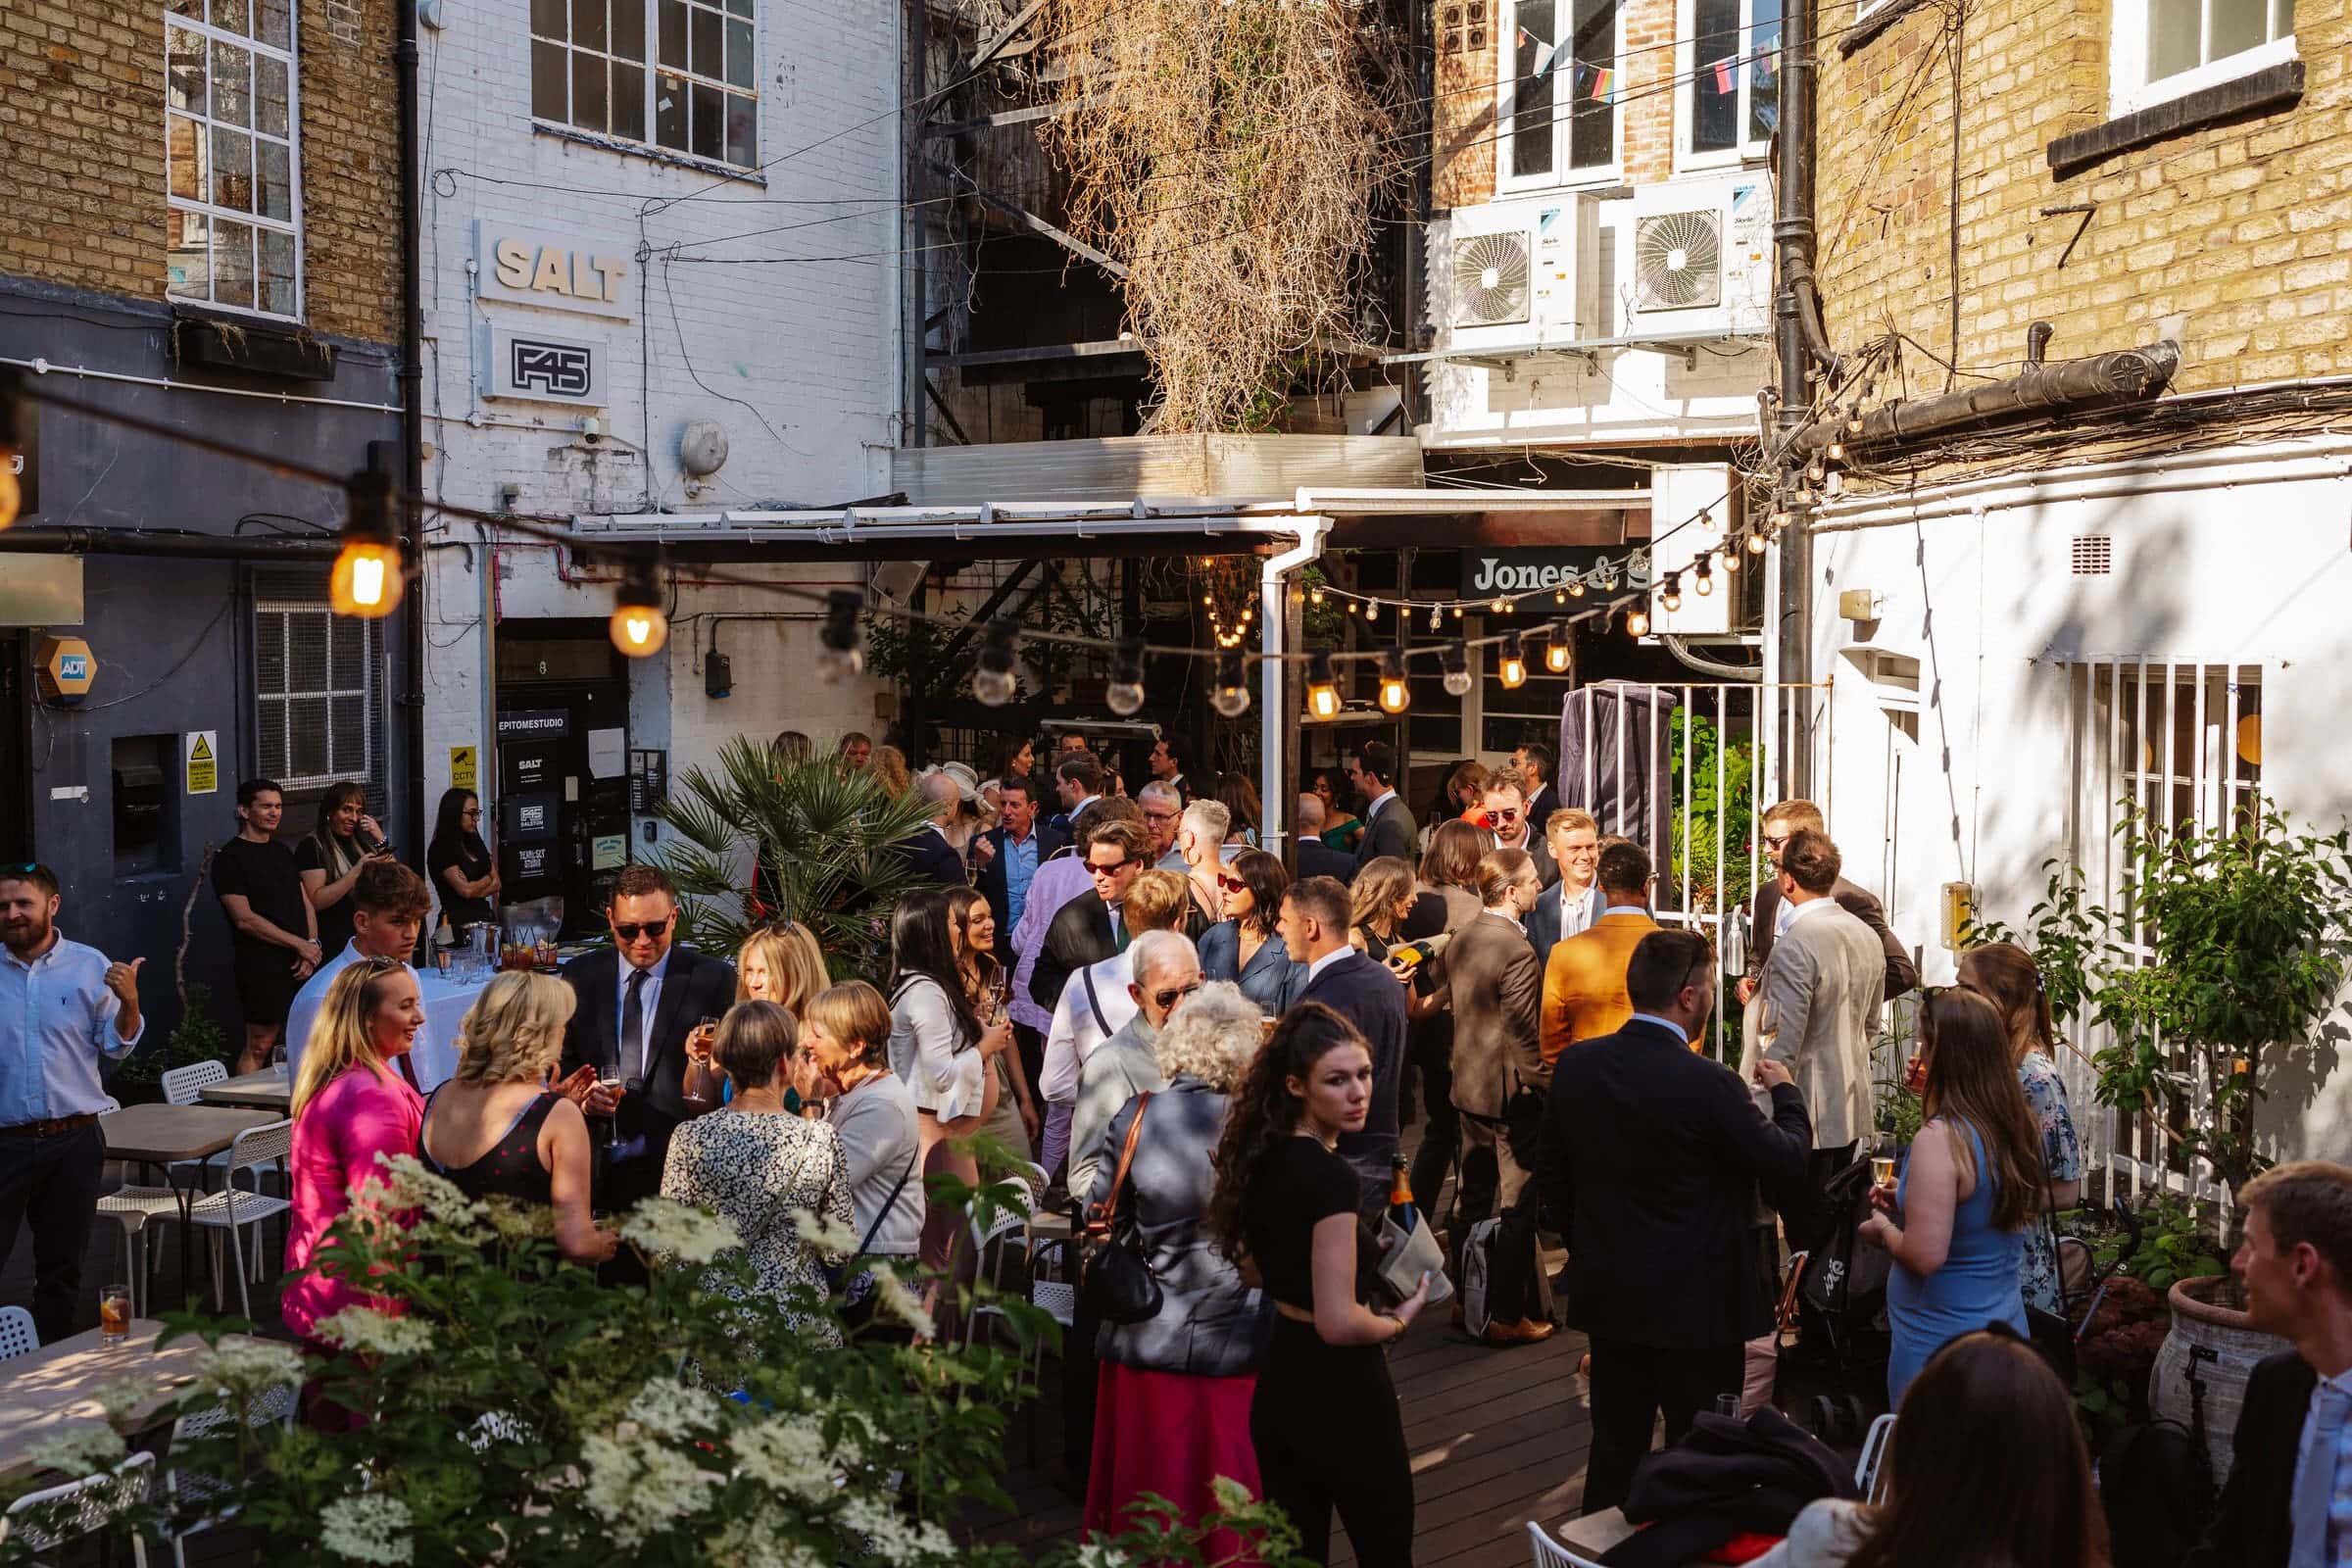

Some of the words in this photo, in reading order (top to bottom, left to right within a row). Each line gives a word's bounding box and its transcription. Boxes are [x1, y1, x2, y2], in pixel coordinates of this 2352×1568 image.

[496, 239, 627, 303] SALT
[512, 339, 591, 397] F45
[1475, 558, 1579, 590] Jones
[1587, 556, 1619, 589] &
[62, 661, 86, 675] ADT
[499, 717, 564, 730] EPITOMESTUDIO
[518, 759, 543, 770] SALT
[454, 770, 475, 781] CCTV
[520, 806, 544, 822] F45
